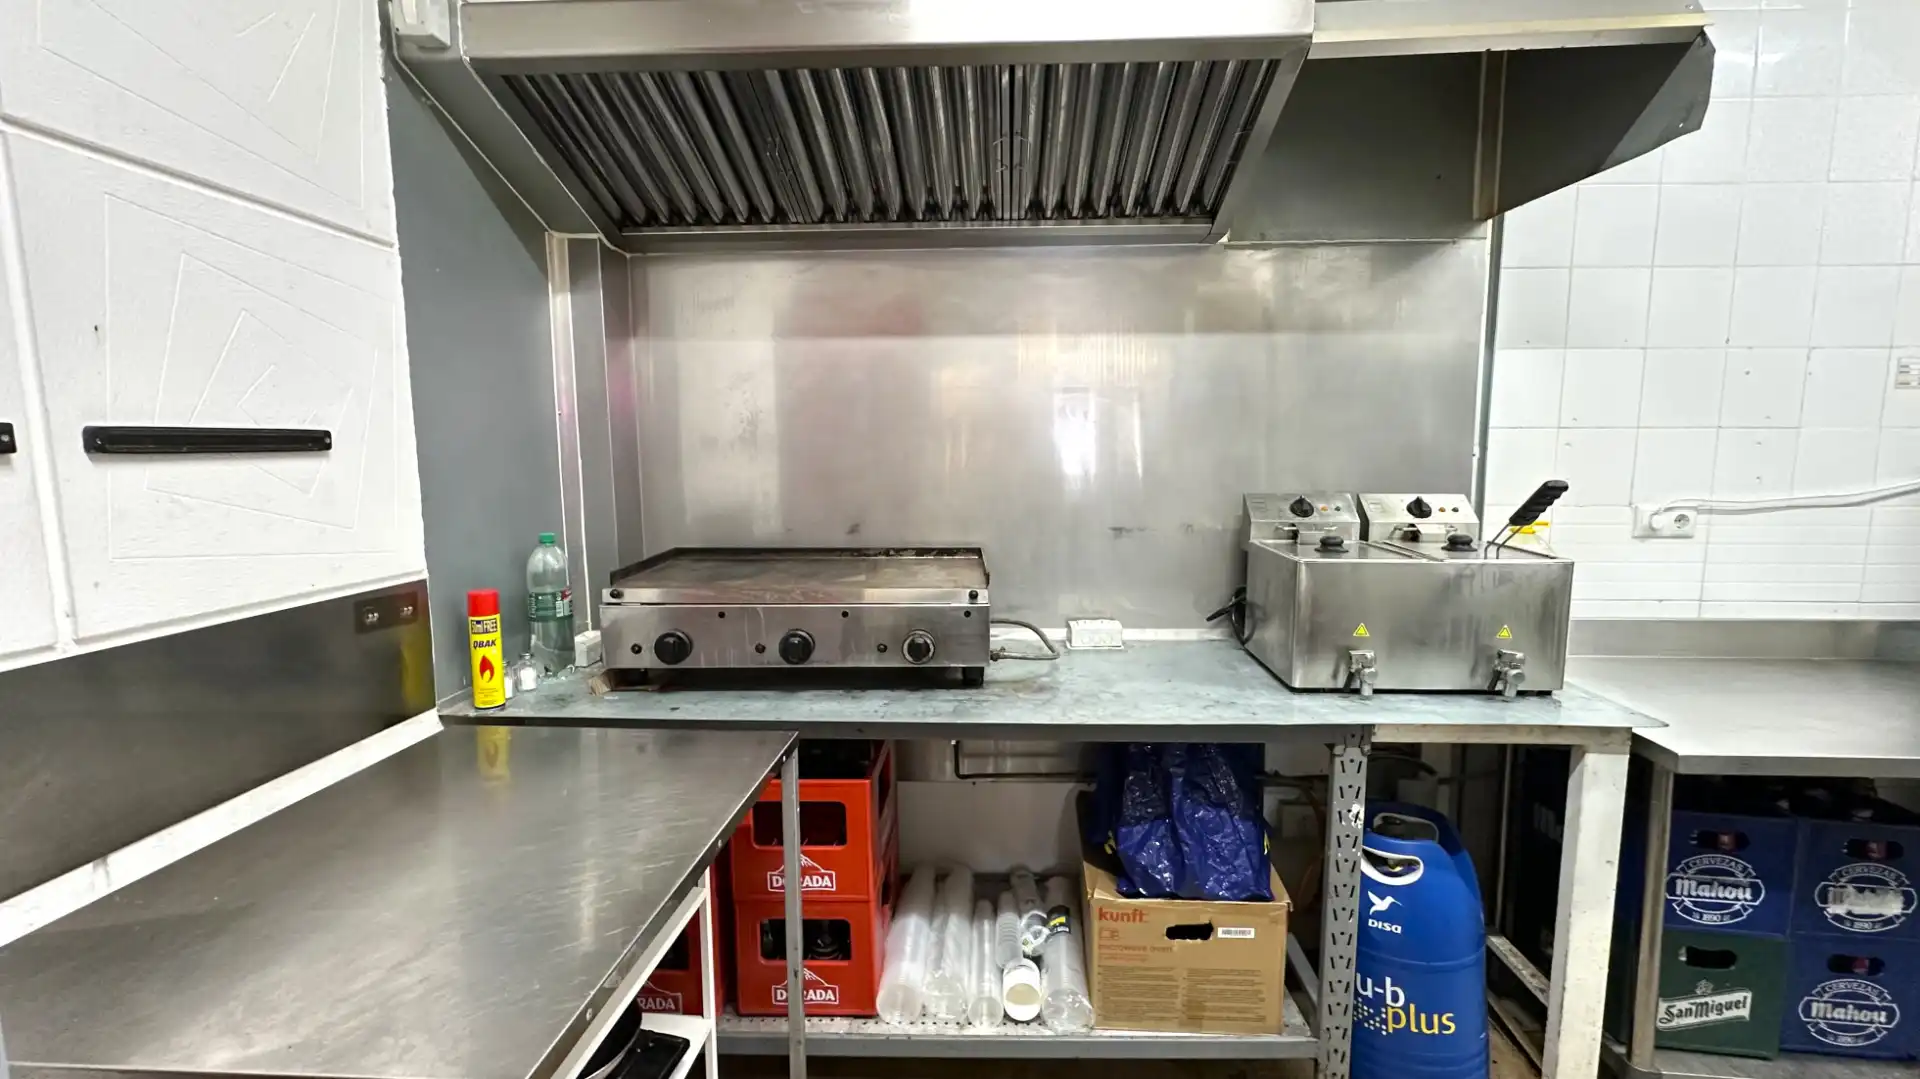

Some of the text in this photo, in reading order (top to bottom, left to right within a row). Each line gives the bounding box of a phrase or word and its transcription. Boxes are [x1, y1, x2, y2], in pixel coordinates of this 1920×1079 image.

[484, 619, 498, 633] FREE
[1688, 857, 1745, 872] CERVEZAS
[771, 875, 832, 888] DADA
[1675, 879, 1752, 901] Mahou
[1097, 907, 1149, 923] kunft
[776, 989, 836, 1001] DADA
[1824, 982, 1880, 997] CERVEZAS
[636, 996, 676, 1010] RADA
[1688, 995, 1748, 1019] Miguel
[1387, 1003, 1456, 1034] plus
[1811, 1001, 1887, 1023] Mahou
